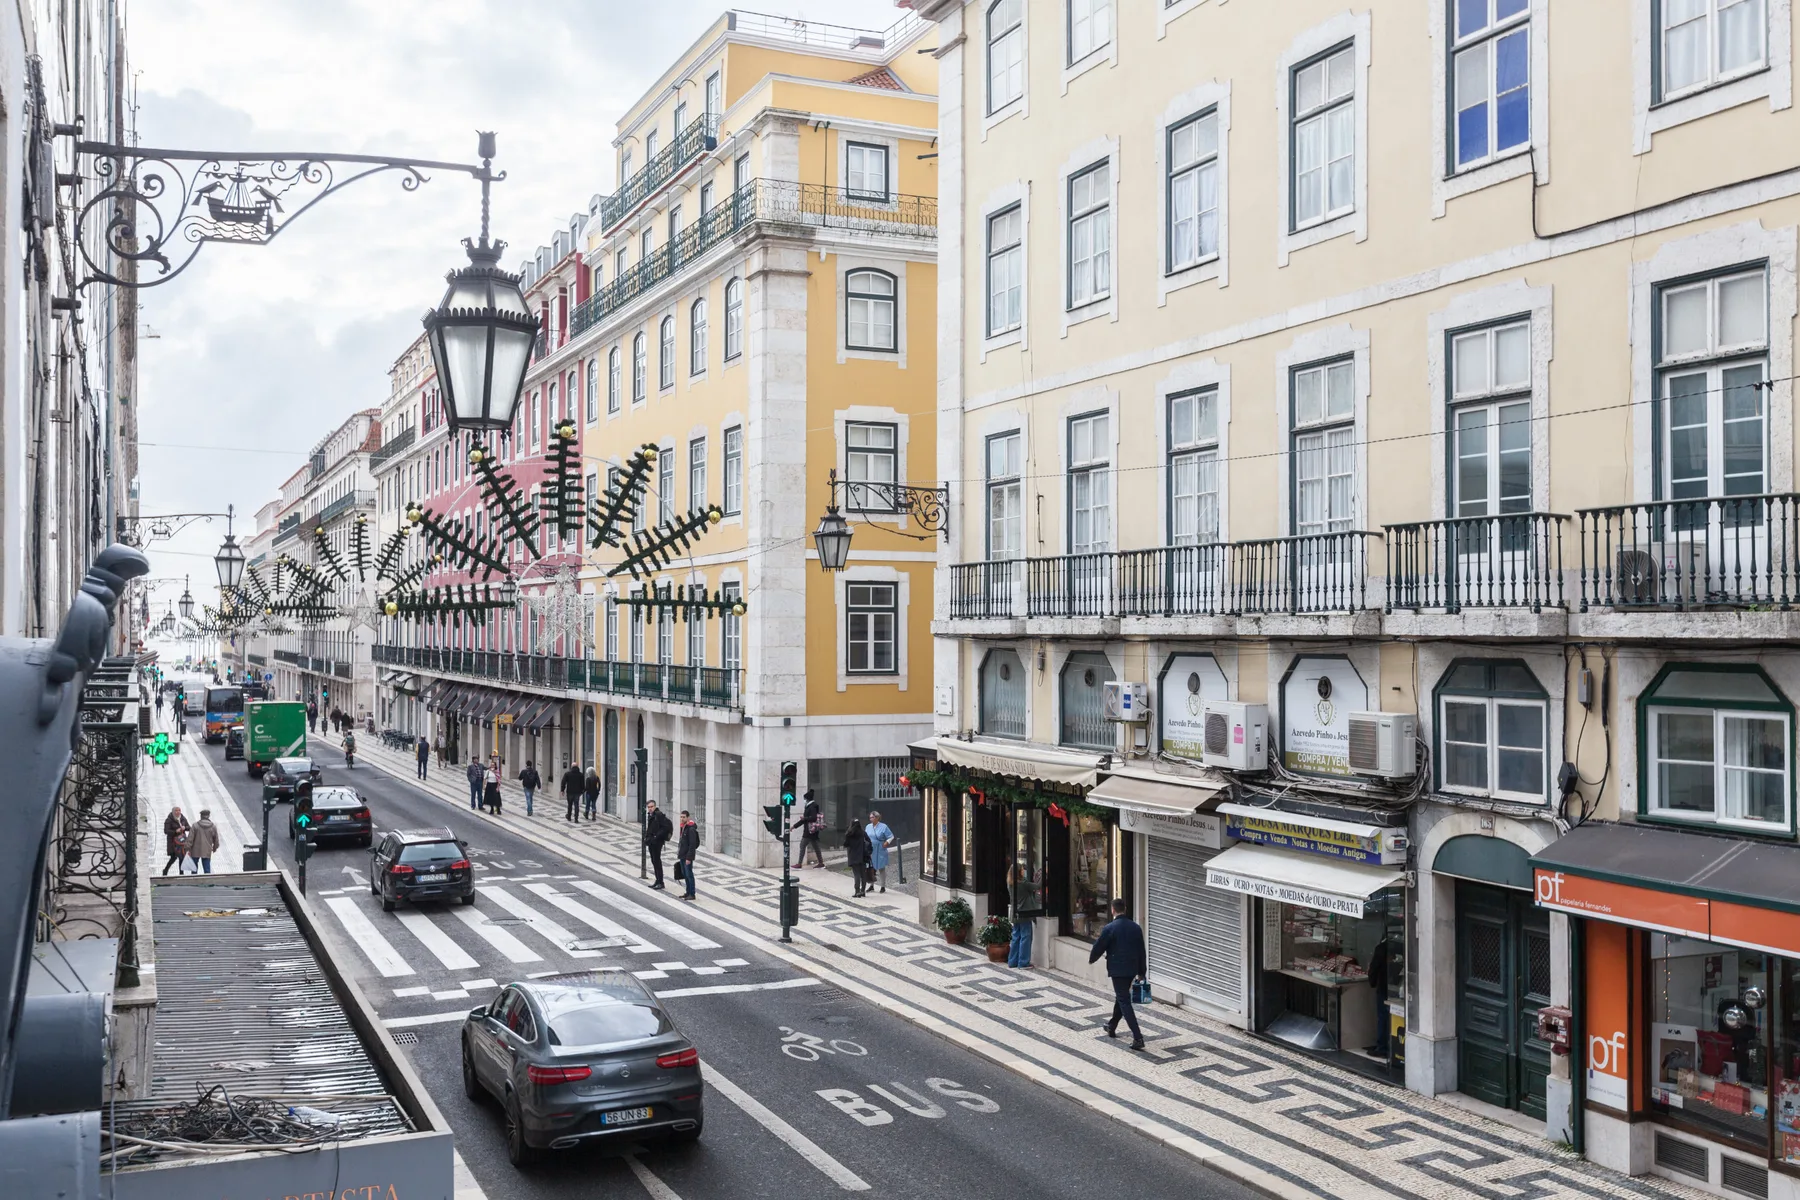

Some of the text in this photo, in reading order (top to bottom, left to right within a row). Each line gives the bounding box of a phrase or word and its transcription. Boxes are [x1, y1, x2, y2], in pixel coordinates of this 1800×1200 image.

[255, 724, 264, 734] C
[1168, 719, 1186, 727] Azevedo
[1188, 720, 1200, 728] Pinho
[1292, 728, 1315, 738] Azevedo
[1316, 730, 1333, 740] Pinho
[1172, 740, 1196, 750] COMPRA
[1298, 753, 1326, 764] COMPRA
[1248, 817, 1279, 832] SOUSA
[1281, 822, 1332, 839] MARQUES
[1240, 828, 1262, 841] Compra
[1270, 834, 1288, 844] Venda
[1292, 837, 1308, 849] Notas
[1317, 843, 1340, 855] Moedas
[1342, 848, 1367, 860] Antigas
[1210, 874, 1230, 886] LIBRAS
[1234, 878, 1250, 890] OURO
[1254, 882, 1274, 896] NOTAS
[1279, 888, 1304, 902] MOEDAS
[1305, 894, 1312, 904] de
[1313, 896, 1332, 908] OURO
[1337, 900, 1359, 914] PRATA
[1538, 872, 1564, 902] pf
[1560, 898, 1612, 912] papelaria fernandes
[1589, 1031, 1626, 1073] pf
[814, 1077, 1001, 1127] BUS
